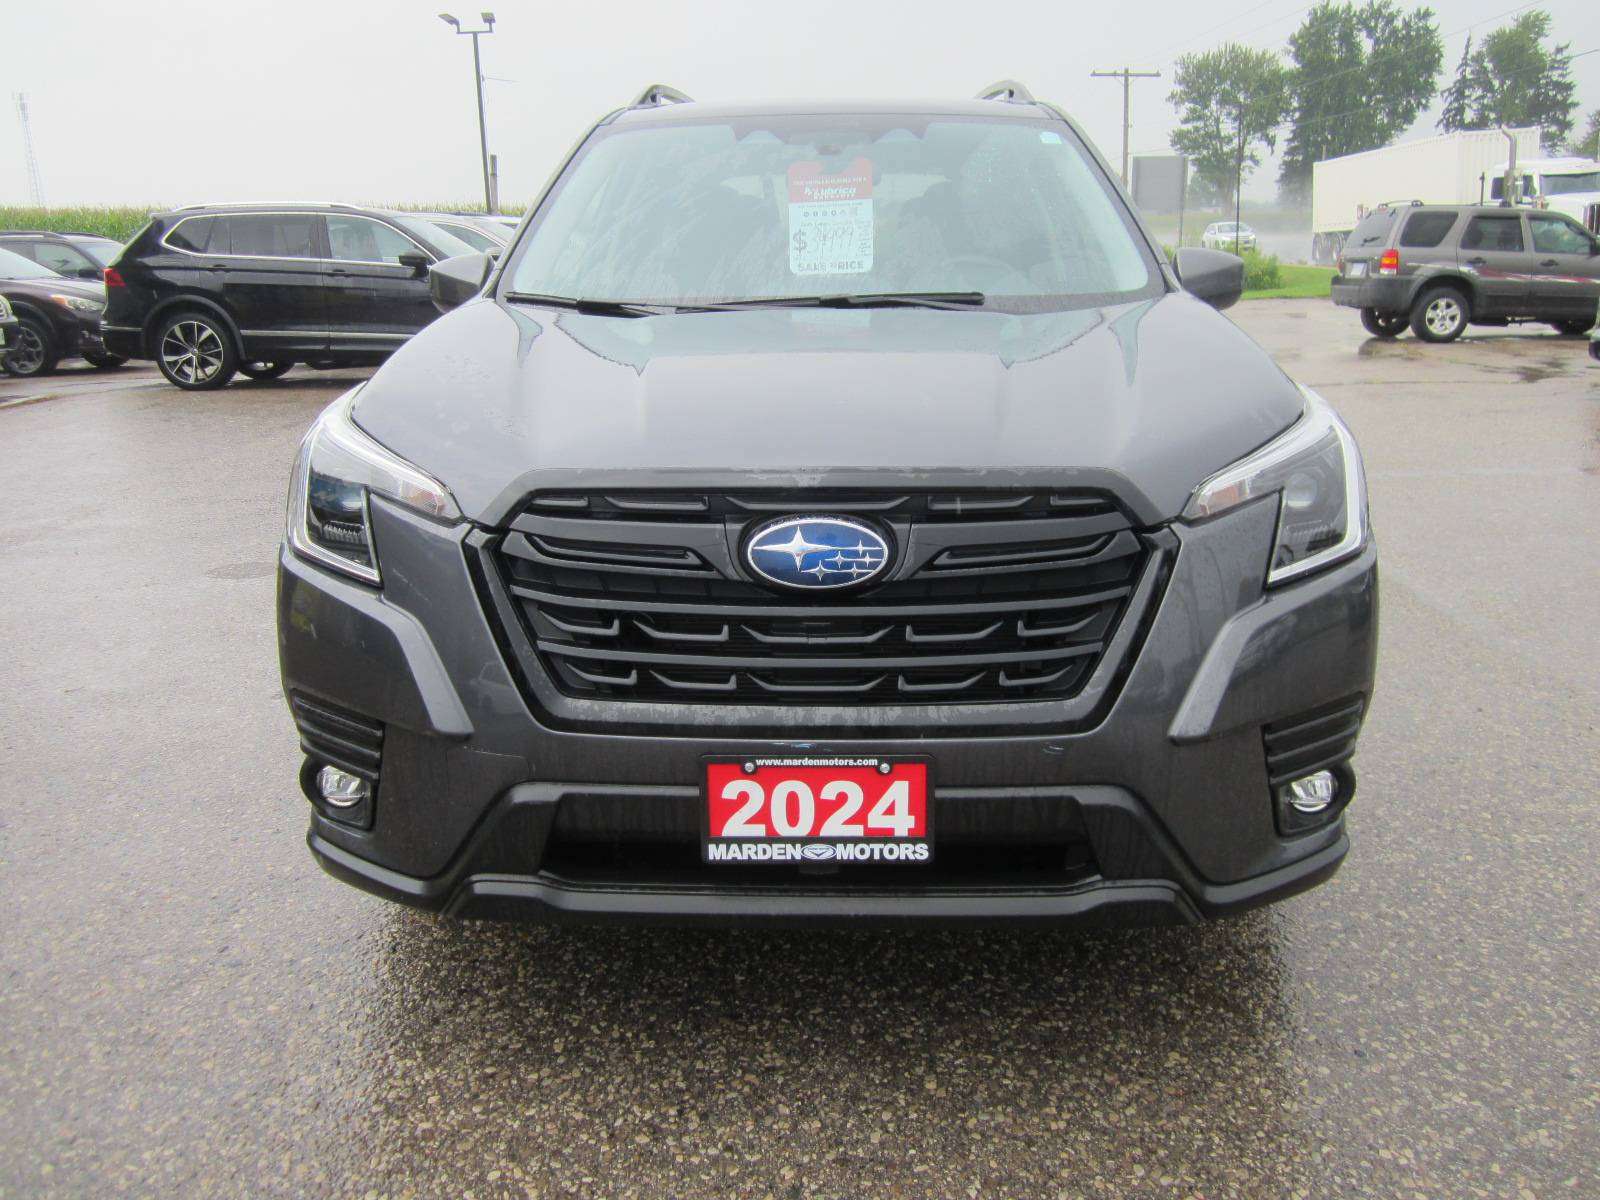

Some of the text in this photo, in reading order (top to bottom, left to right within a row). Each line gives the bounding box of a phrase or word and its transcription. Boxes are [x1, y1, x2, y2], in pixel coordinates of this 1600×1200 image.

[756, 757, 878, 766] www.mardenmotors.com
[721, 779, 915, 837] 2024
[708, 843, 929, 860] MARDEN MOTORS
